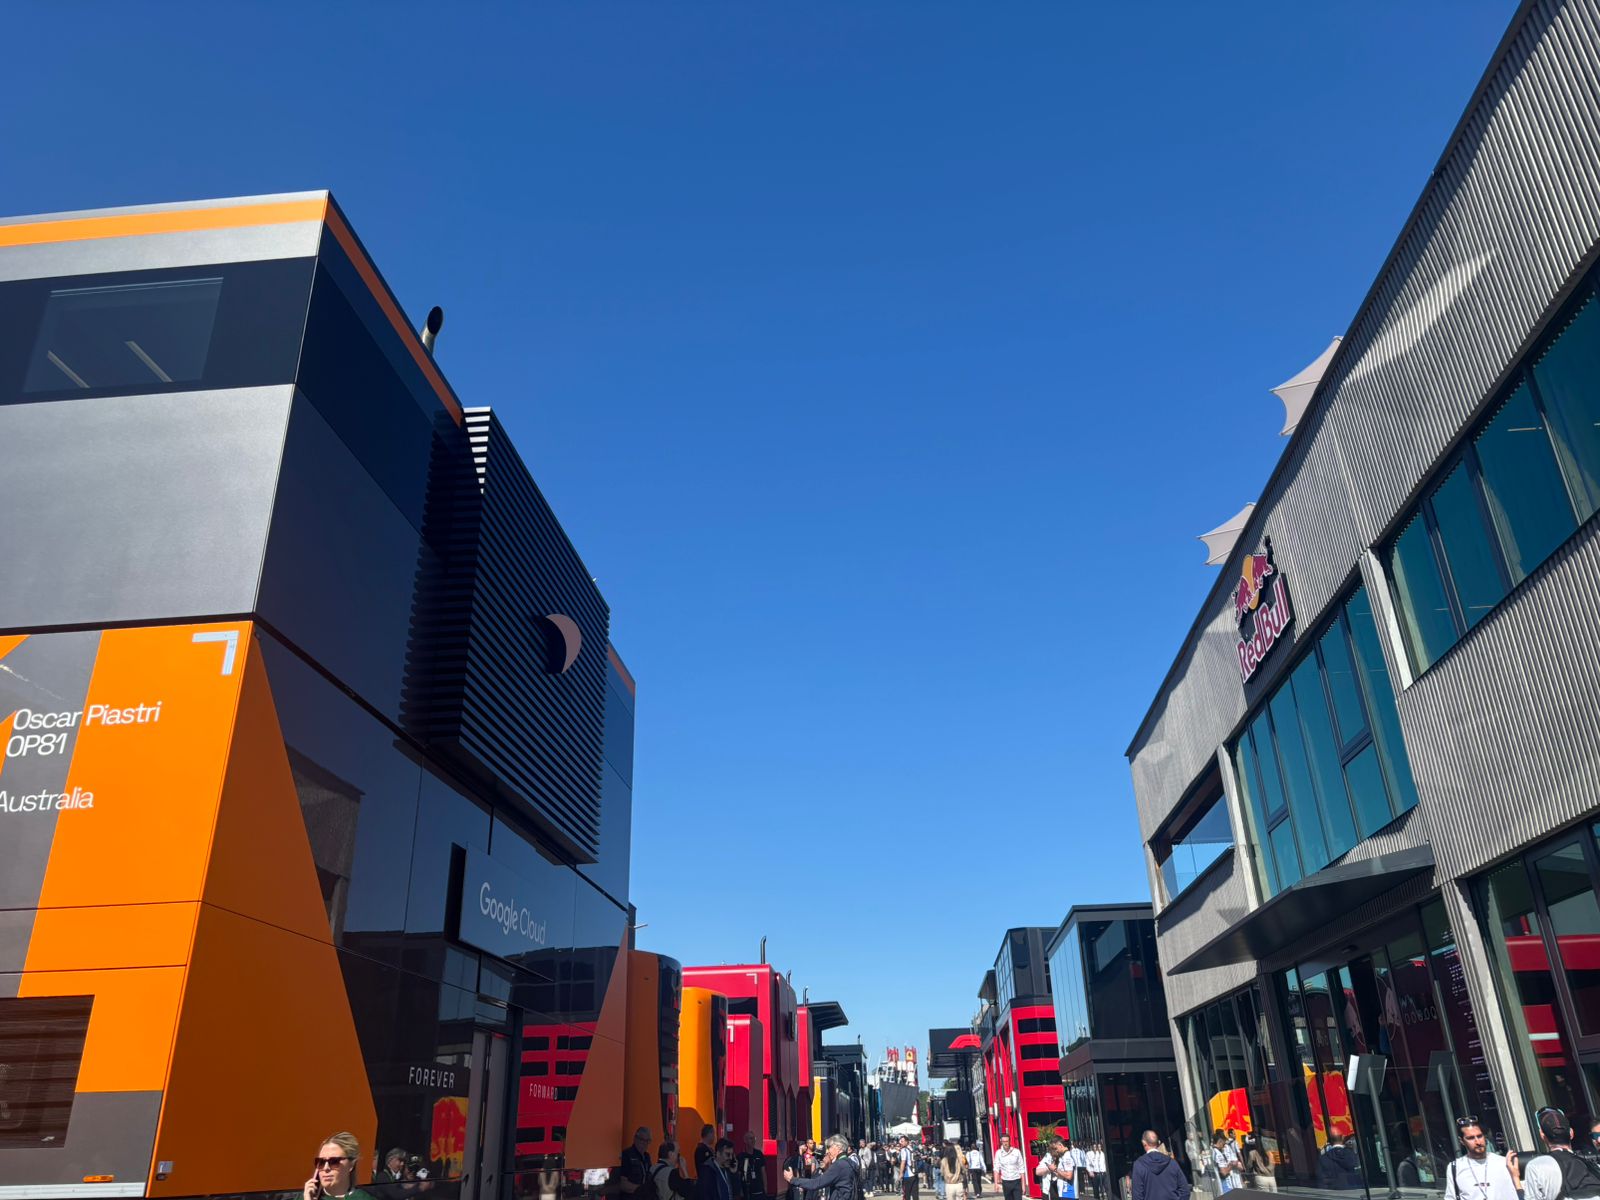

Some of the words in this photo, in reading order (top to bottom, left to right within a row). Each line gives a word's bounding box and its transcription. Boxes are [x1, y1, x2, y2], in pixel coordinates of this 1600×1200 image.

[13, 708, 83, 731] Oscar
[86, 701, 162, 726] Piastri
[6, 733, 68, 757] OP81
[480, 882, 518, 935] Google
[519, 908, 547, 945] Cloud
[409, 1067, 456, 1088] FOREVER
[528, 1084, 559, 1100] FORWARD
